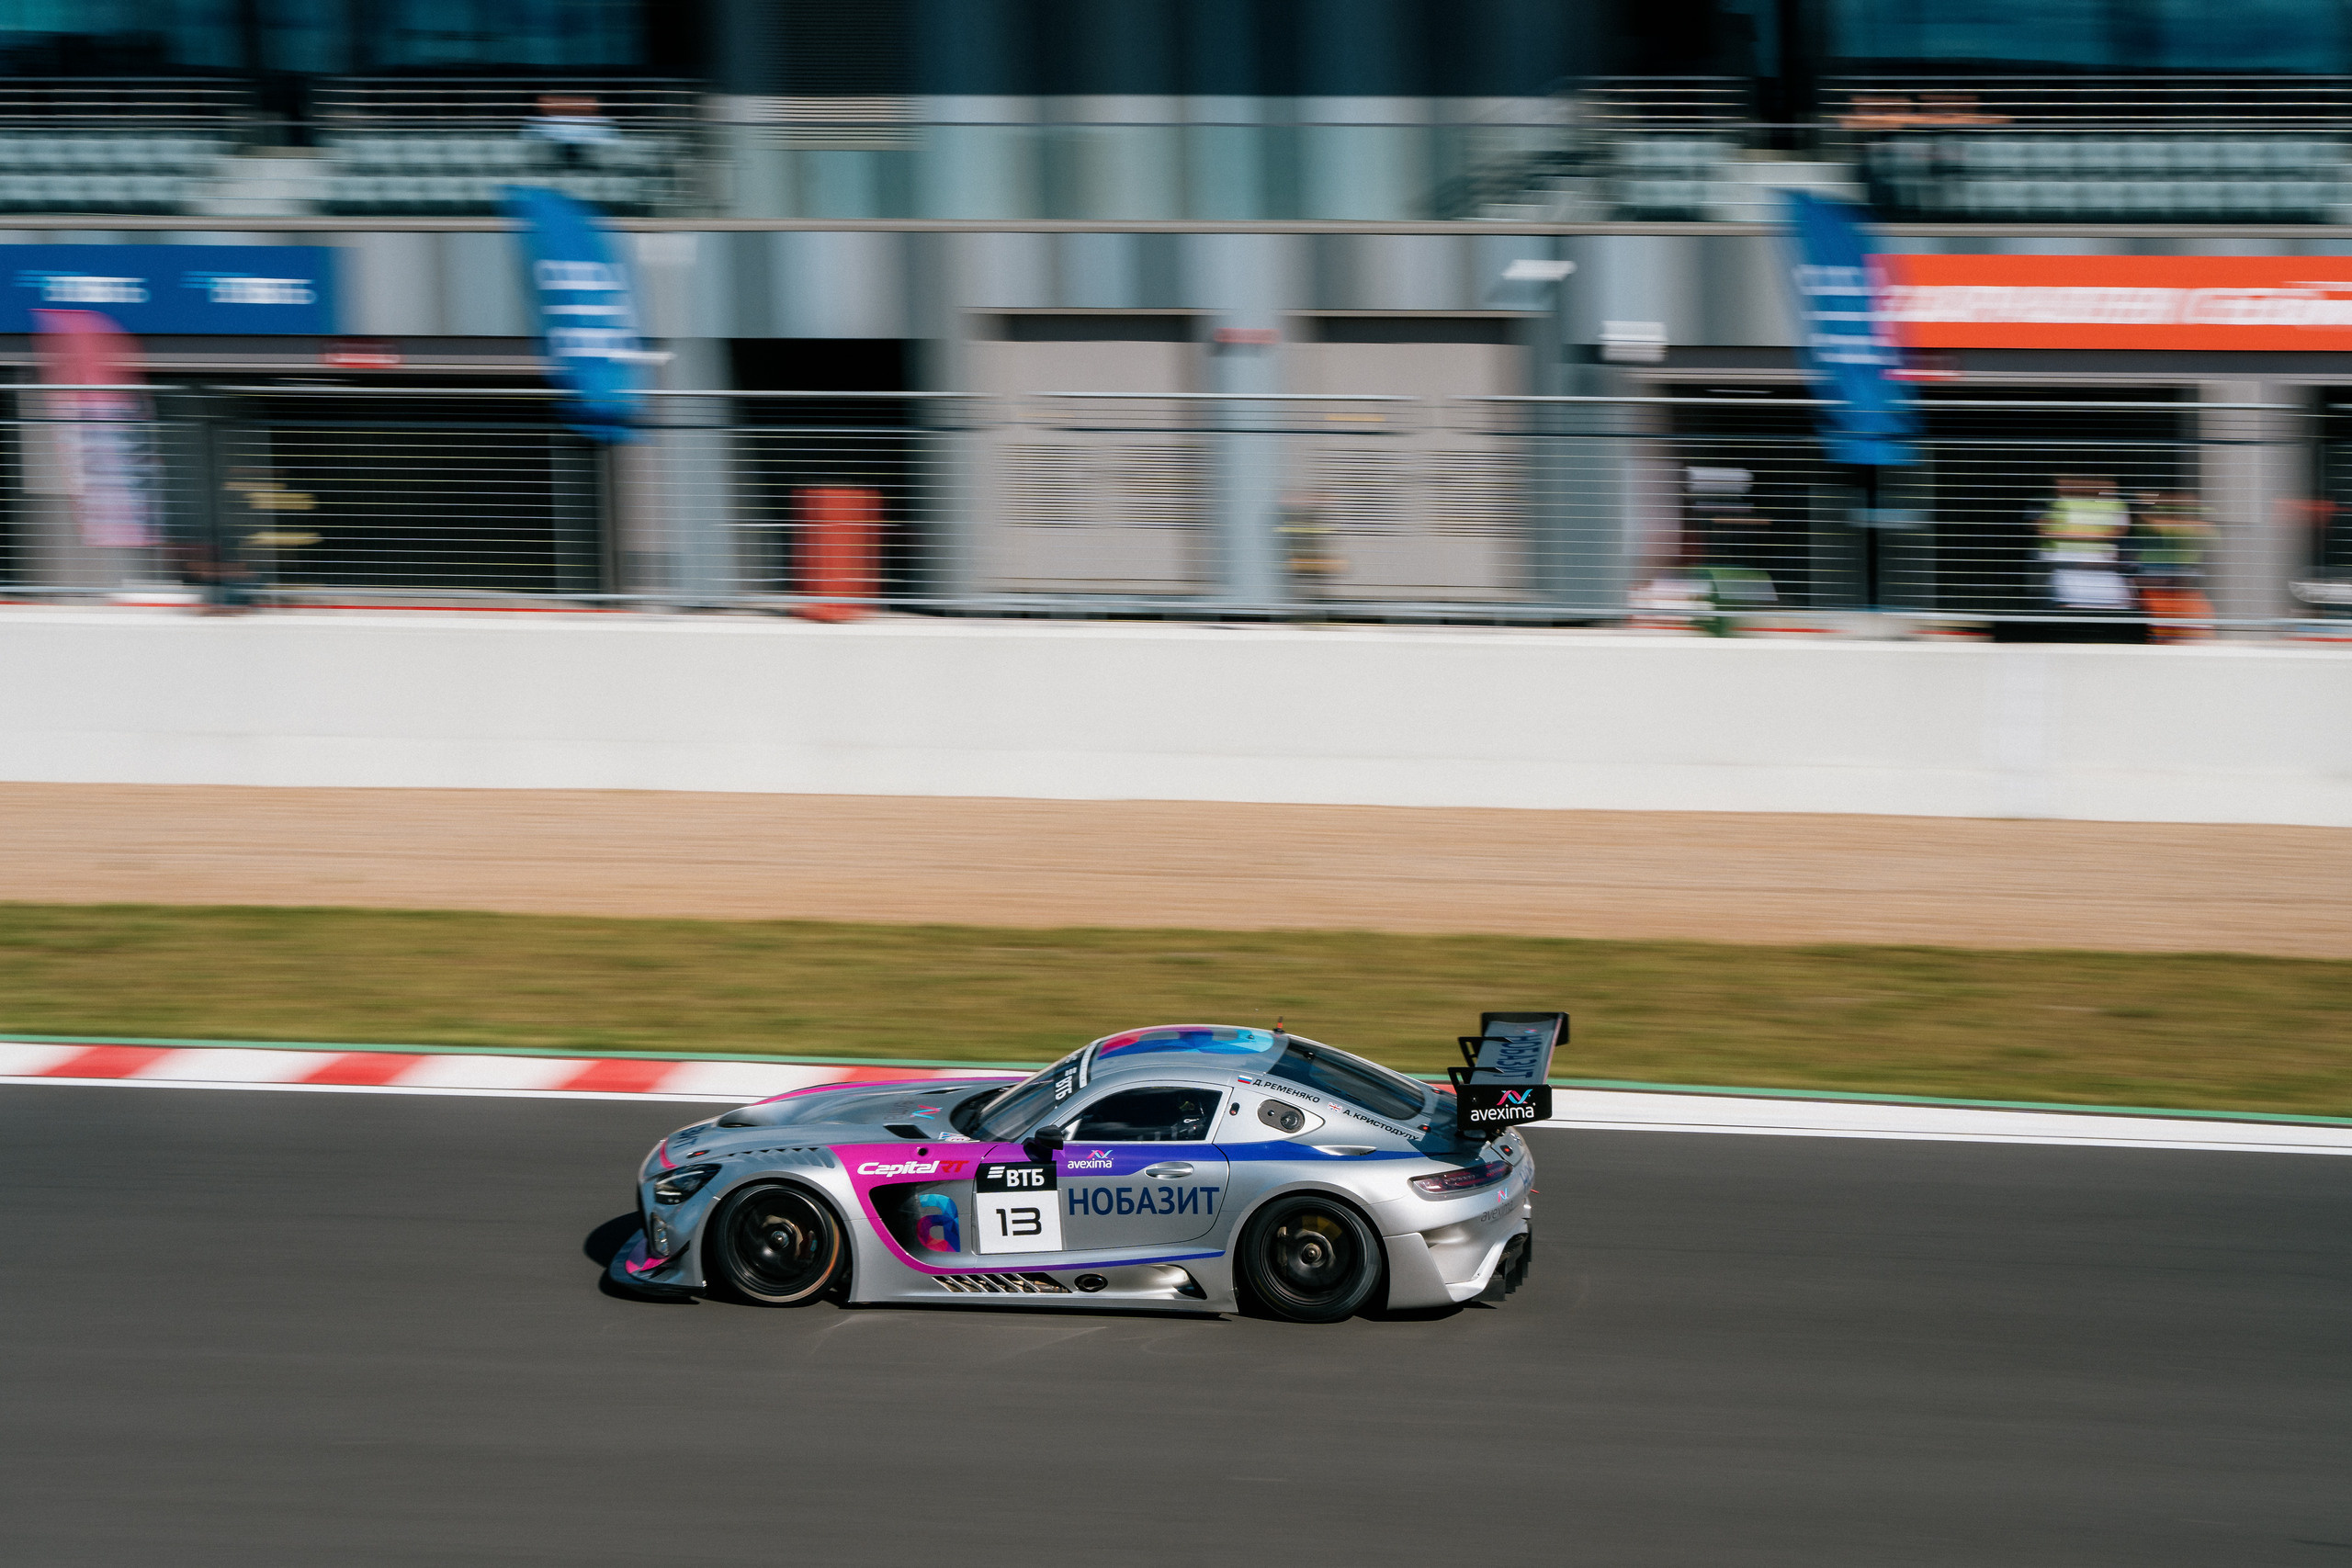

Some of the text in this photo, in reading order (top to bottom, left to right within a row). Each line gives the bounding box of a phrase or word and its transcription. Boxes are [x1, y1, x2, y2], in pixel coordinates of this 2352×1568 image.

[1471, 1103, 1535, 1122] avexima
[1067, 1157, 1114, 1169] avexima
[1006, 1168, 1046, 1188] ВТБ
[1068, 1186, 1220, 1216] НОБАЗИТ
[995, 1206, 1043, 1237] 13
